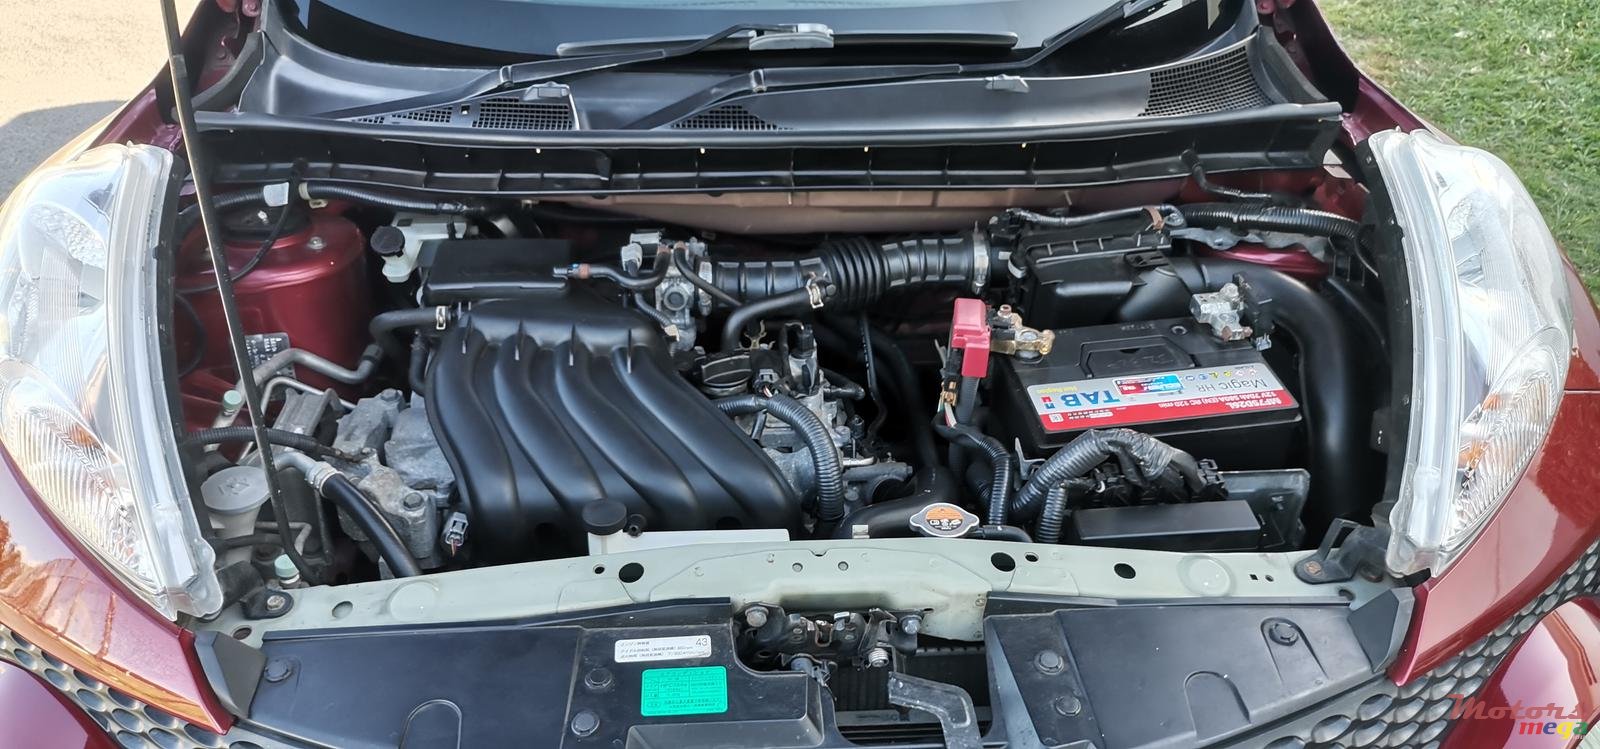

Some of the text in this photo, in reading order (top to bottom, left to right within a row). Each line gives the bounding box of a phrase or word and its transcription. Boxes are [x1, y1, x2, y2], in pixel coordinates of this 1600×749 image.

[1196, 384, 1215, 393] HR
[1218, 378, 1268, 391] Magic
[1060, 390, 1121, 408] TAB
[696, 638, 708, 646] 43
